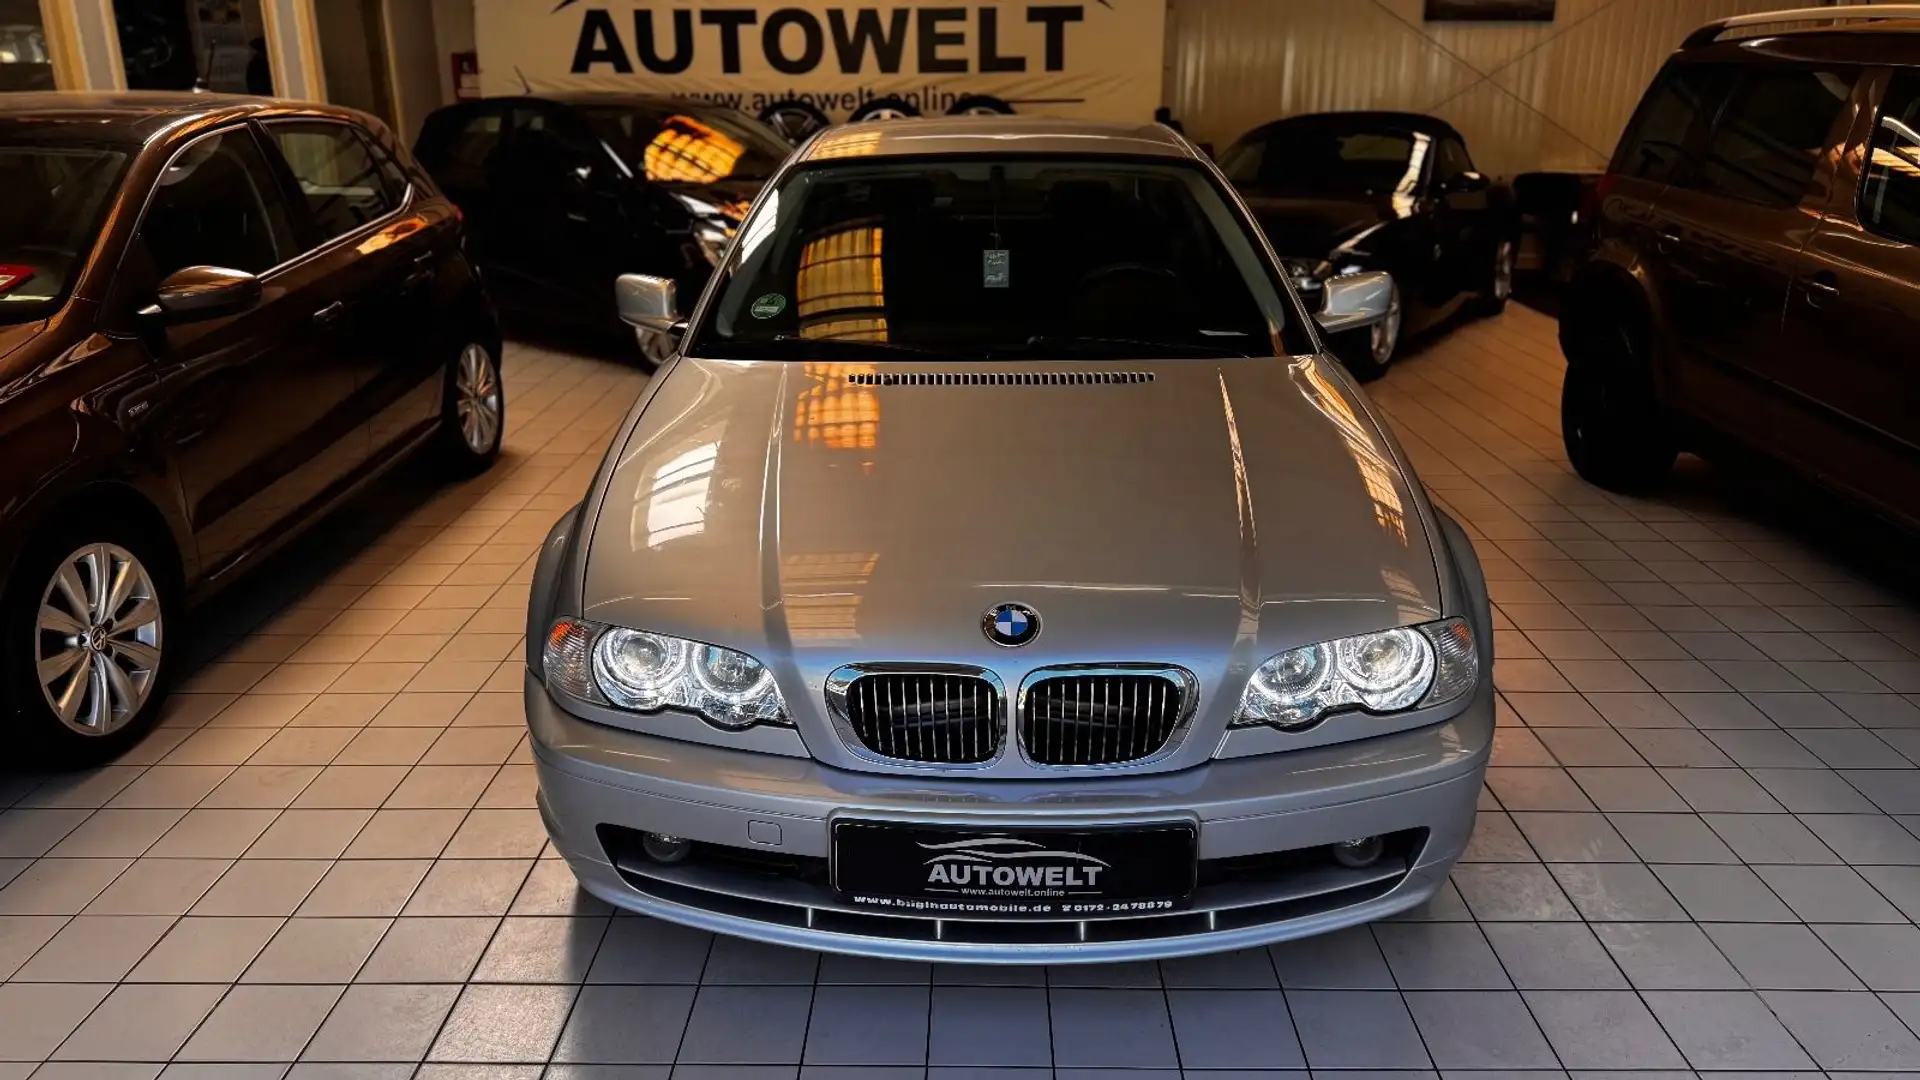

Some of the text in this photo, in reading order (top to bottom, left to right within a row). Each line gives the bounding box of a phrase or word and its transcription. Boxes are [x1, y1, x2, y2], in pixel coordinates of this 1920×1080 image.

[570, 6, 1084, 75] AUTOWELT
[927, 863, 1103, 887] AUTOWELT
[961, 887, 1065, 898] www.autowelt.online
